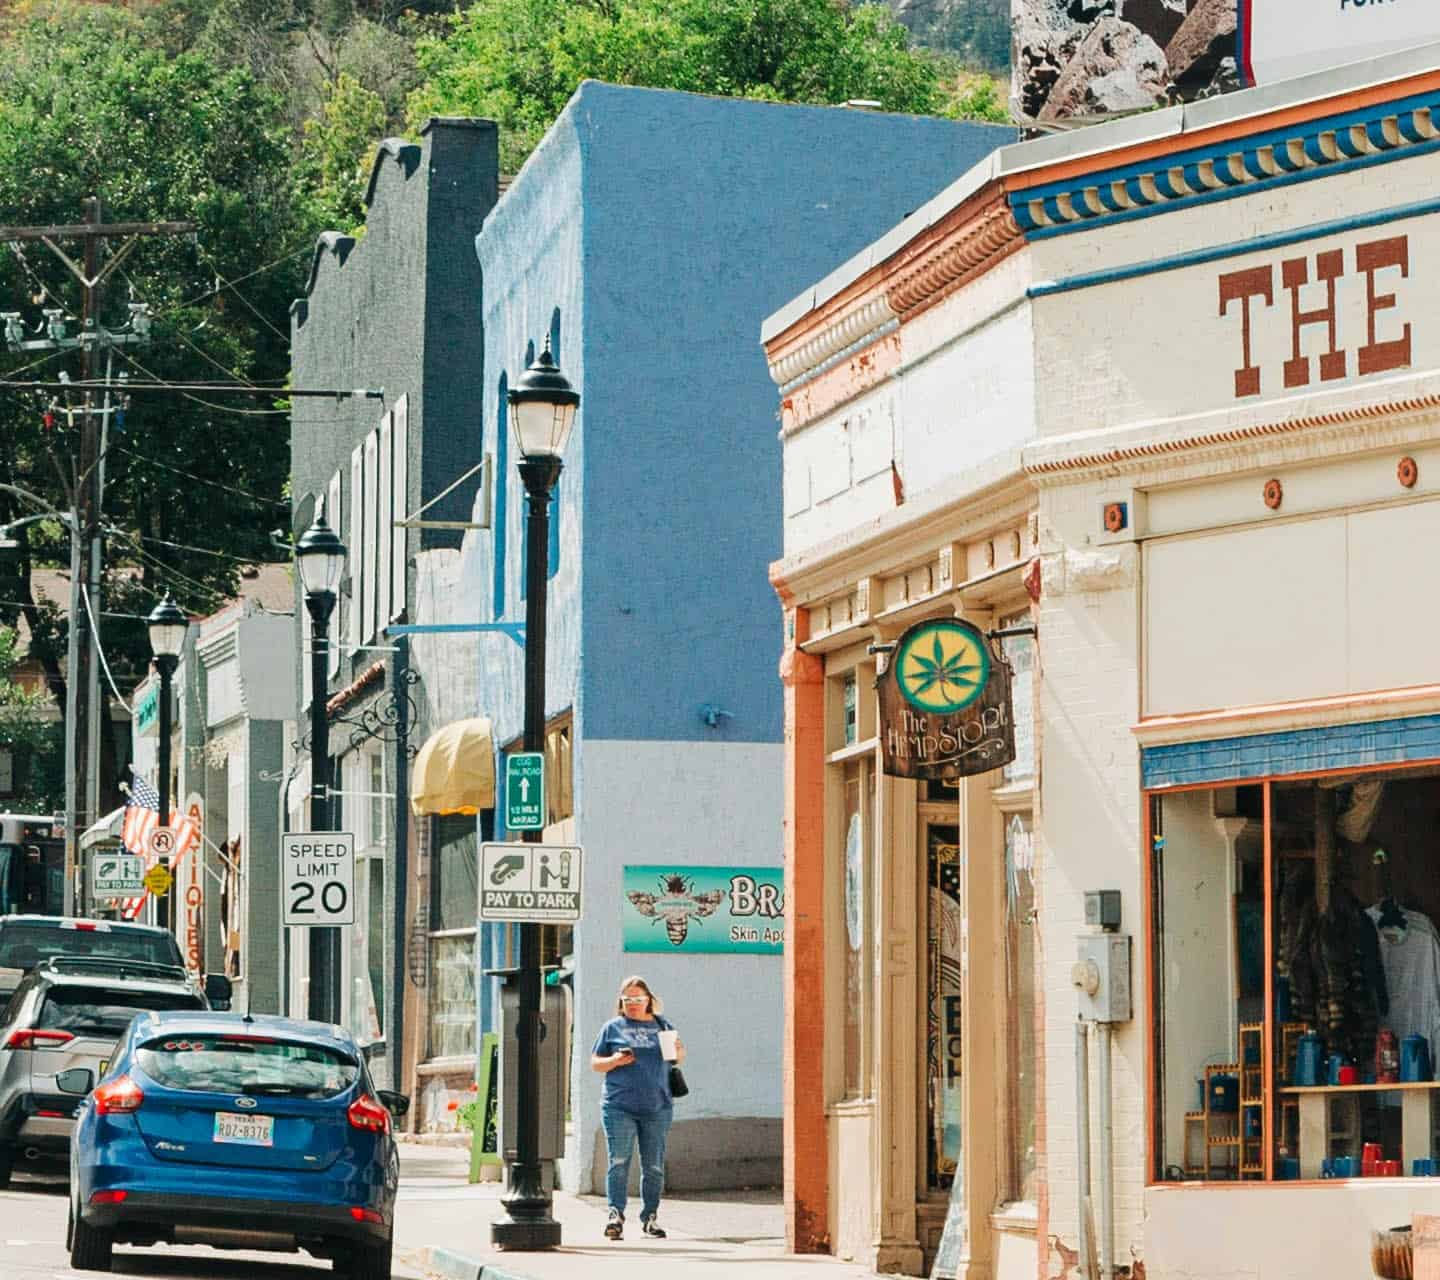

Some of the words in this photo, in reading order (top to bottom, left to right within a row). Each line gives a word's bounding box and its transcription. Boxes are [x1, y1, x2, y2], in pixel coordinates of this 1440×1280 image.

[1217, 233, 1413, 399] THE
[899, 709, 928, 732] The
[290, 844, 347, 858] SPEED
[297, 863, 340, 877] LIMIT
[290, 882, 347, 914] 20
[486, 892, 512, 906] PAY
[515, 893, 534, 907] TO
[537, 893, 576, 908] PARK
[730, 875, 784, 919] BR
[731, 926, 758, 941] Skin
